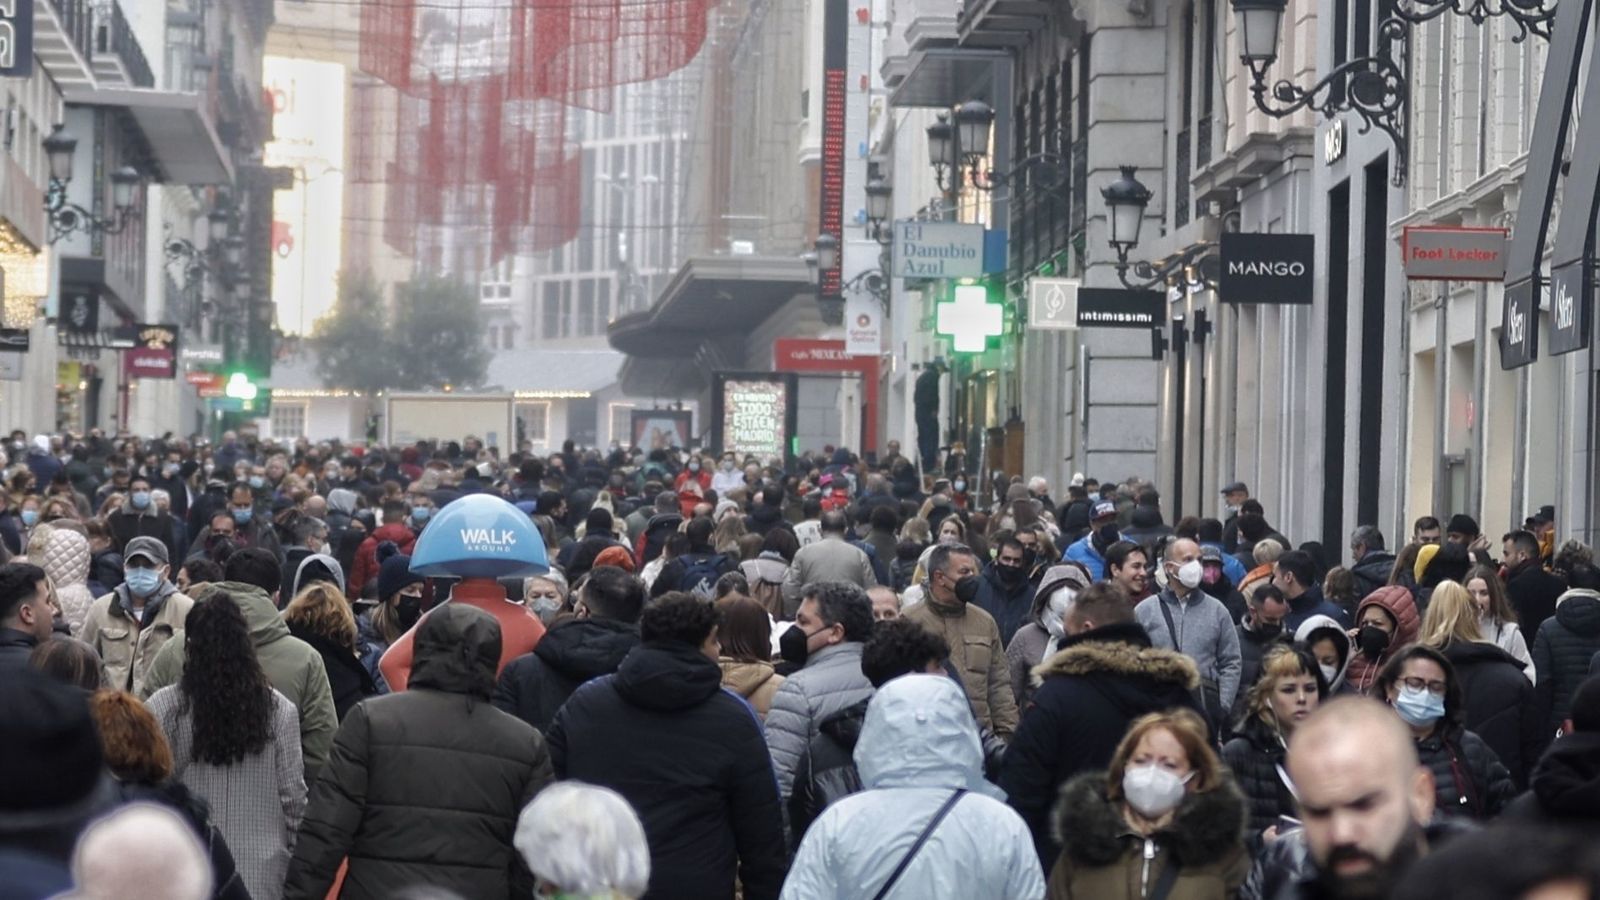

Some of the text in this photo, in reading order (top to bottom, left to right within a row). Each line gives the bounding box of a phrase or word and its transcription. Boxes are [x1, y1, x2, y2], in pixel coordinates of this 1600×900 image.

[904, 225, 923, 240] El
[903, 243, 976, 259] Danubio
[1412, 247, 1498, 261] Foot Locker
[904, 260, 944, 275] Azul
[1229, 261, 1305, 276] MANGO
[1080, 311, 1153, 323] intimissimi
[738, 402, 771, 416] TODO
[460, 528, 516, 545] WALK
